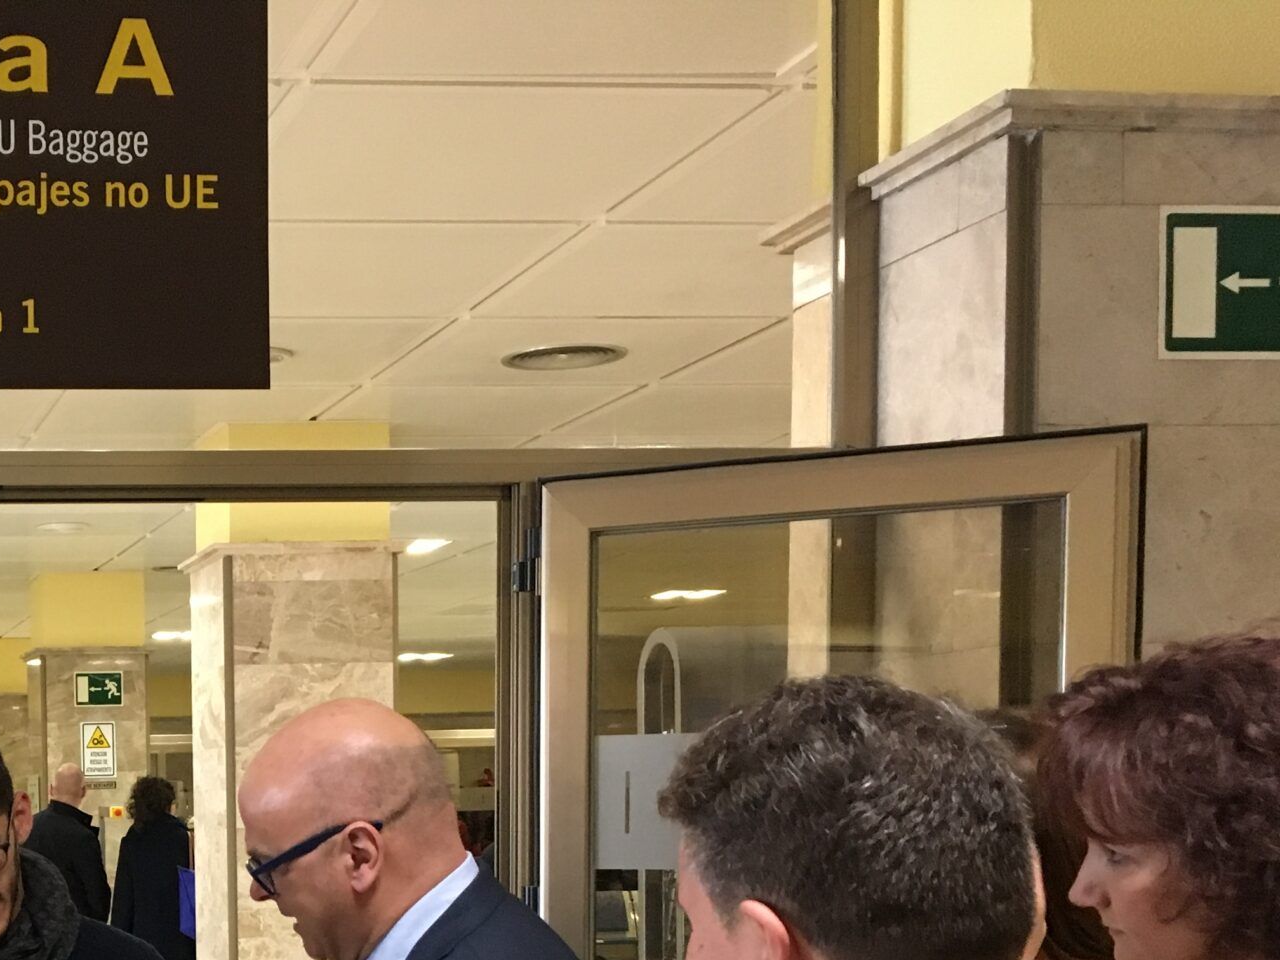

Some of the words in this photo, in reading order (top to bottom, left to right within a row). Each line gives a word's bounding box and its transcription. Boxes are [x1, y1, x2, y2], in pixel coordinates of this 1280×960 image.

[96, 18, 174, 96] A
[29, 120, 148, 164] Baggage
[106, 182, 148, 208] no
[166, 174, 218, 208] UE
[22, 299, 39, 333] 1
